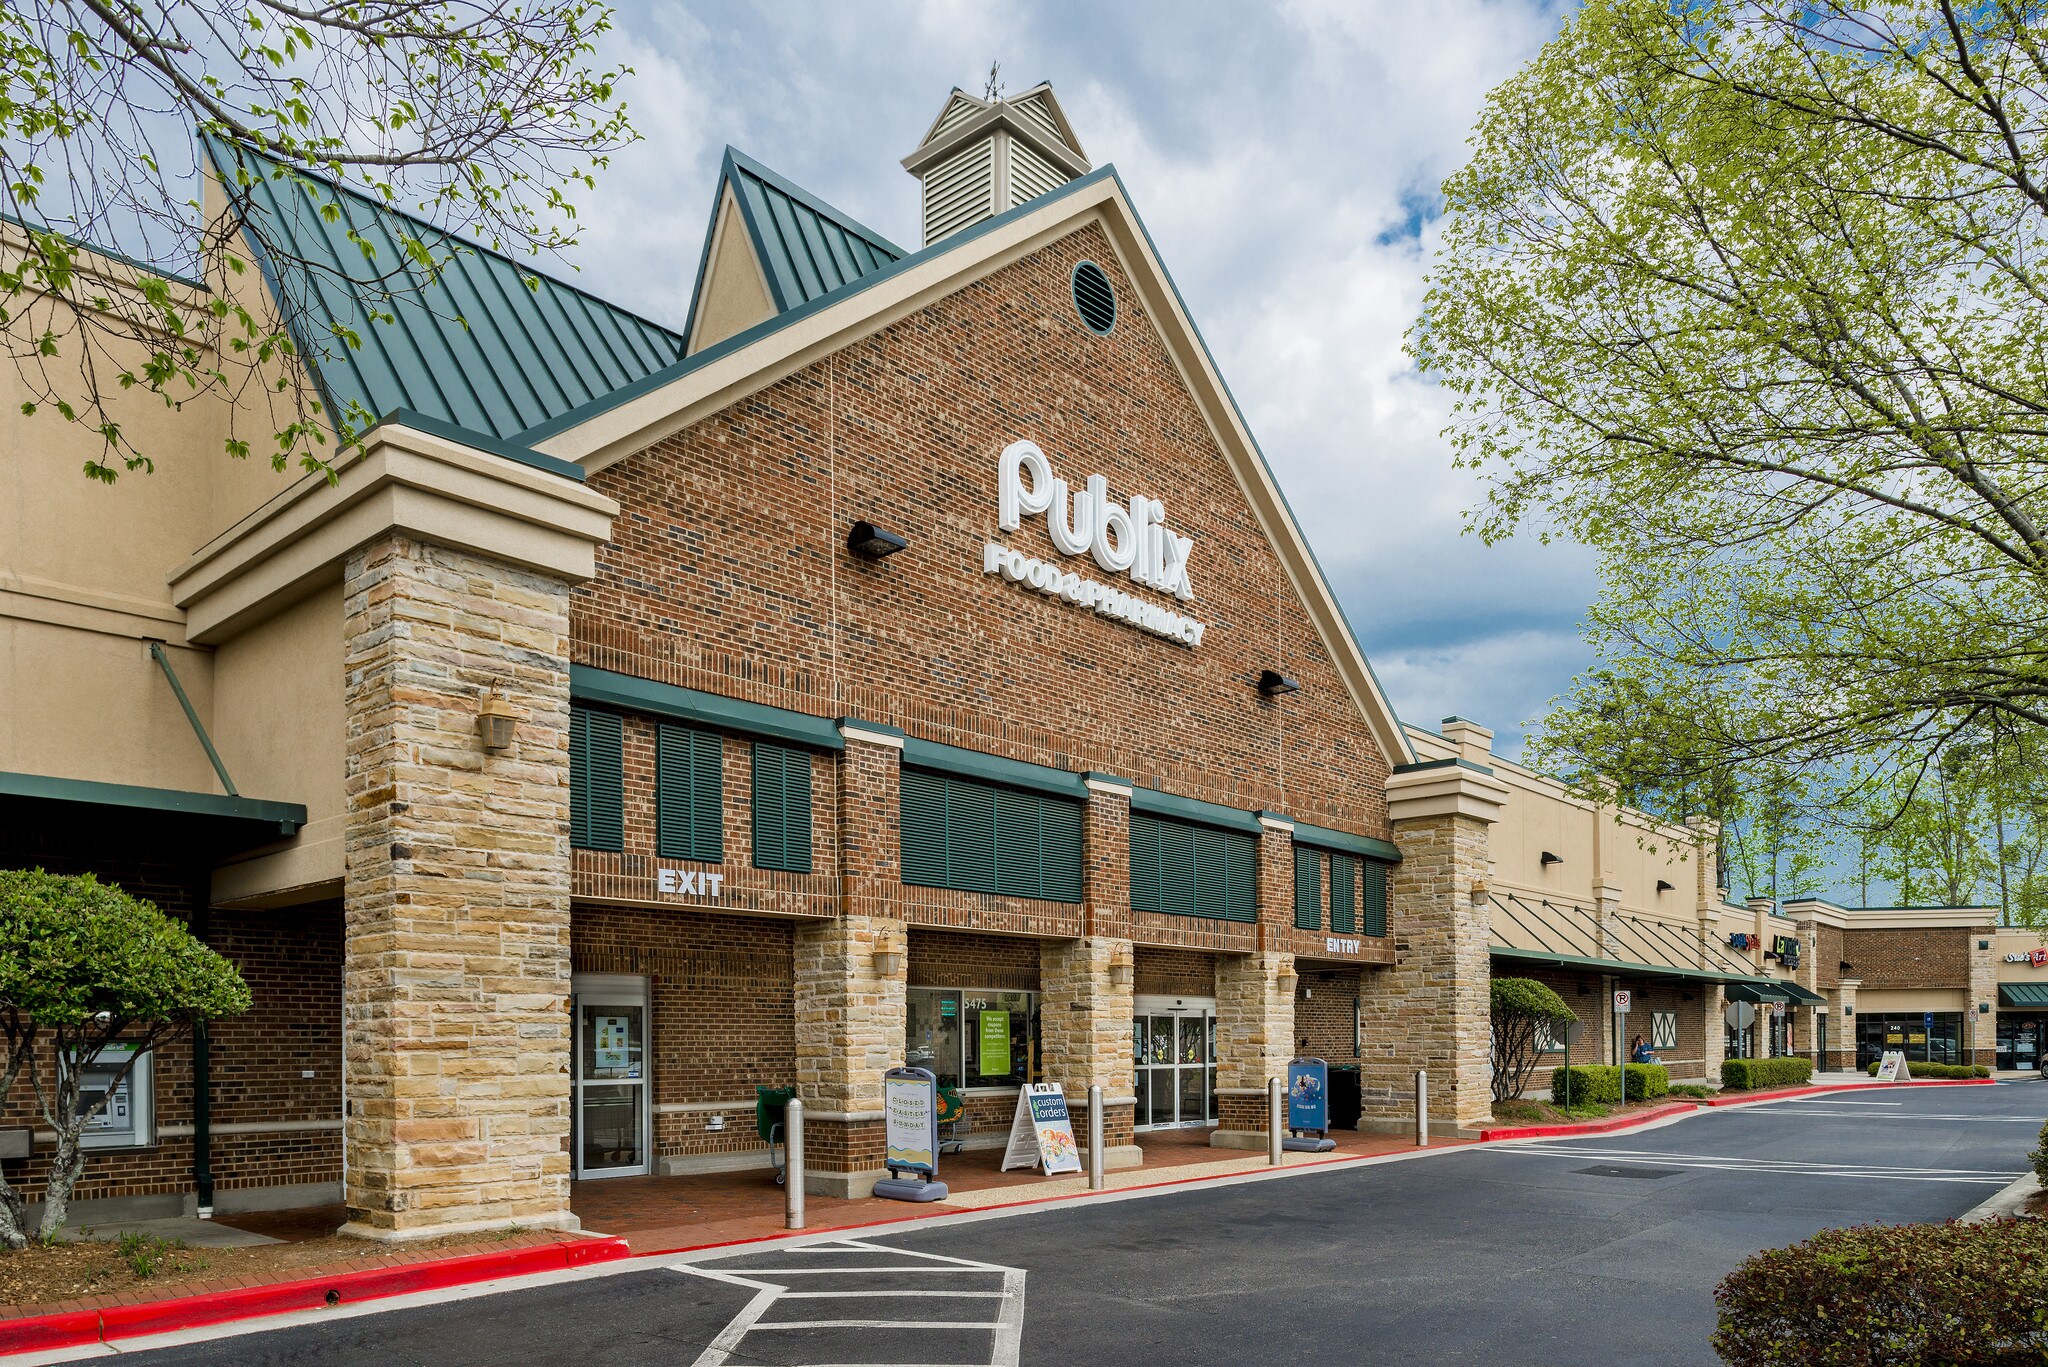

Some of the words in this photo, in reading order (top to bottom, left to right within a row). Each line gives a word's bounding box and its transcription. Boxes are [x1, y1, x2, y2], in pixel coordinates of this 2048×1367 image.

[998, 439, 1194, 600] Publix
[984, 543, 1063, 596] FOOD
[1079, 579, 1206, 647] PHARMACY
[658, 868, 724, 897] EXIT
[1326, 937, 1360, 954] ENTRY
[2005, 952, 2030, 962] Sue's
[964, 998, 987, 1010] 5475
[892, 1096, 925, 1106] CLOSED
[1037, 1097, 1064, 1107] custom
[1039, 1106, 1066, 1118] orders
[892, 1119, 925, 1128] SUNDAY
